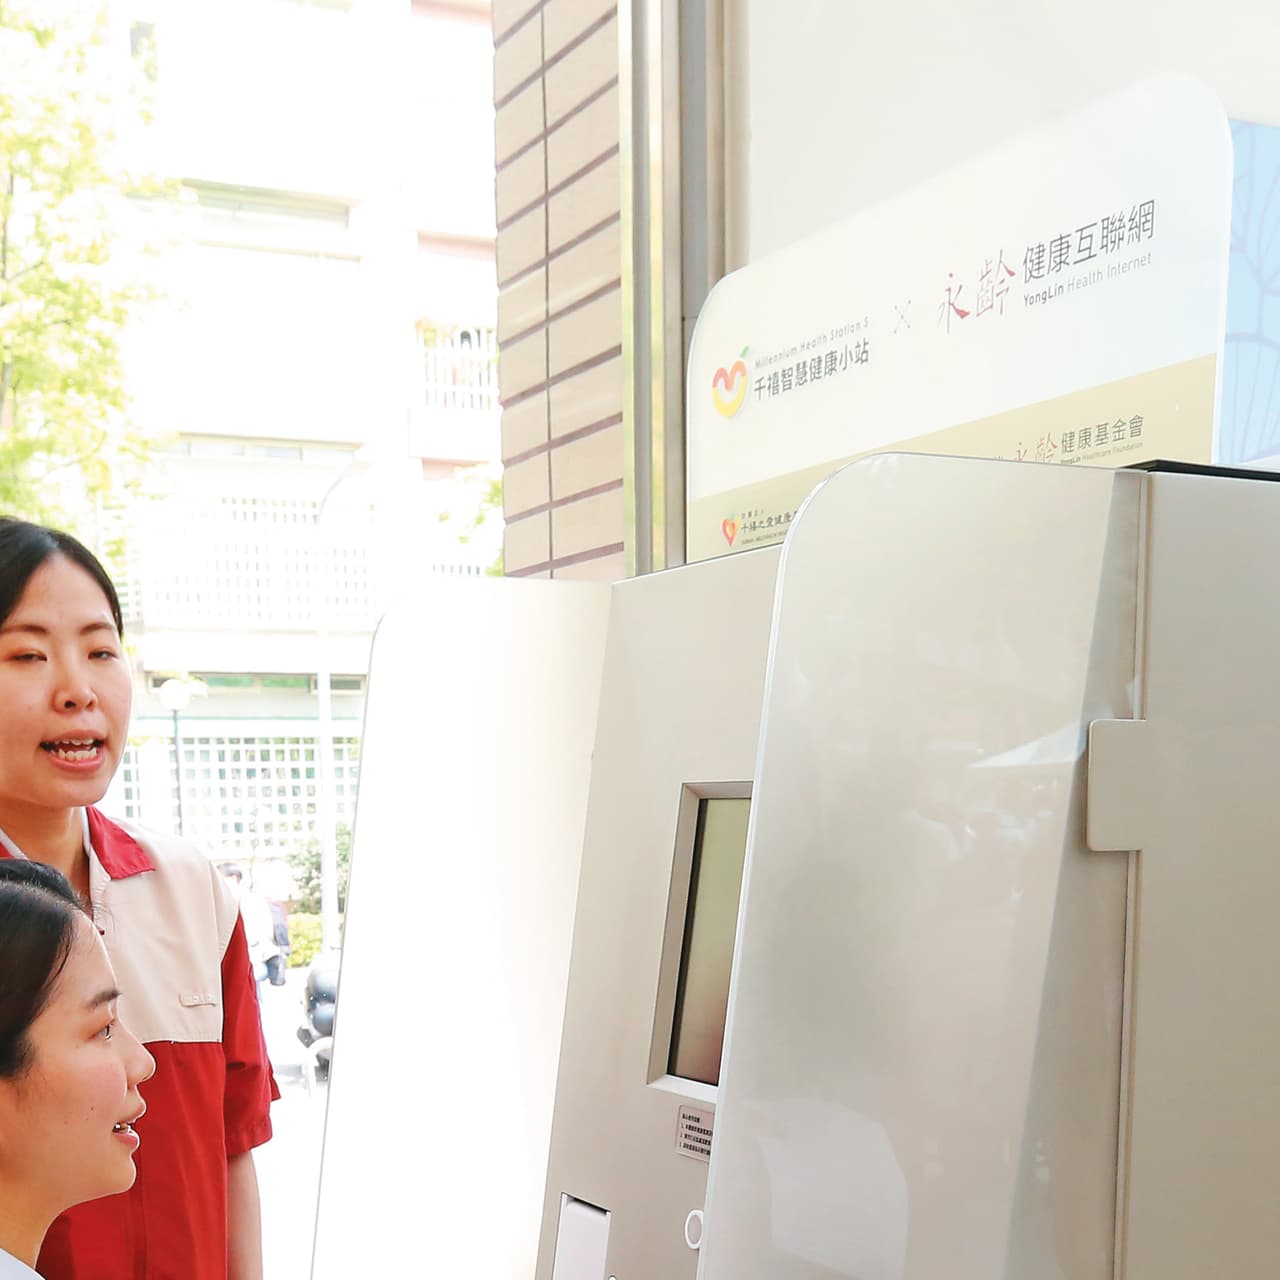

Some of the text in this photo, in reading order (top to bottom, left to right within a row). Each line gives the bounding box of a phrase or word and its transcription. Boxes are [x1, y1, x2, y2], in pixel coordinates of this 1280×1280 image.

[1022, 199, 1155, 284] 健康互聯網
[1023, 252, 1152, 307] YongLin Health Internet
[754, 337, 869, 400] 千禧智慧健康小站
[1061, 414, 1144, 454] 健康基金會
